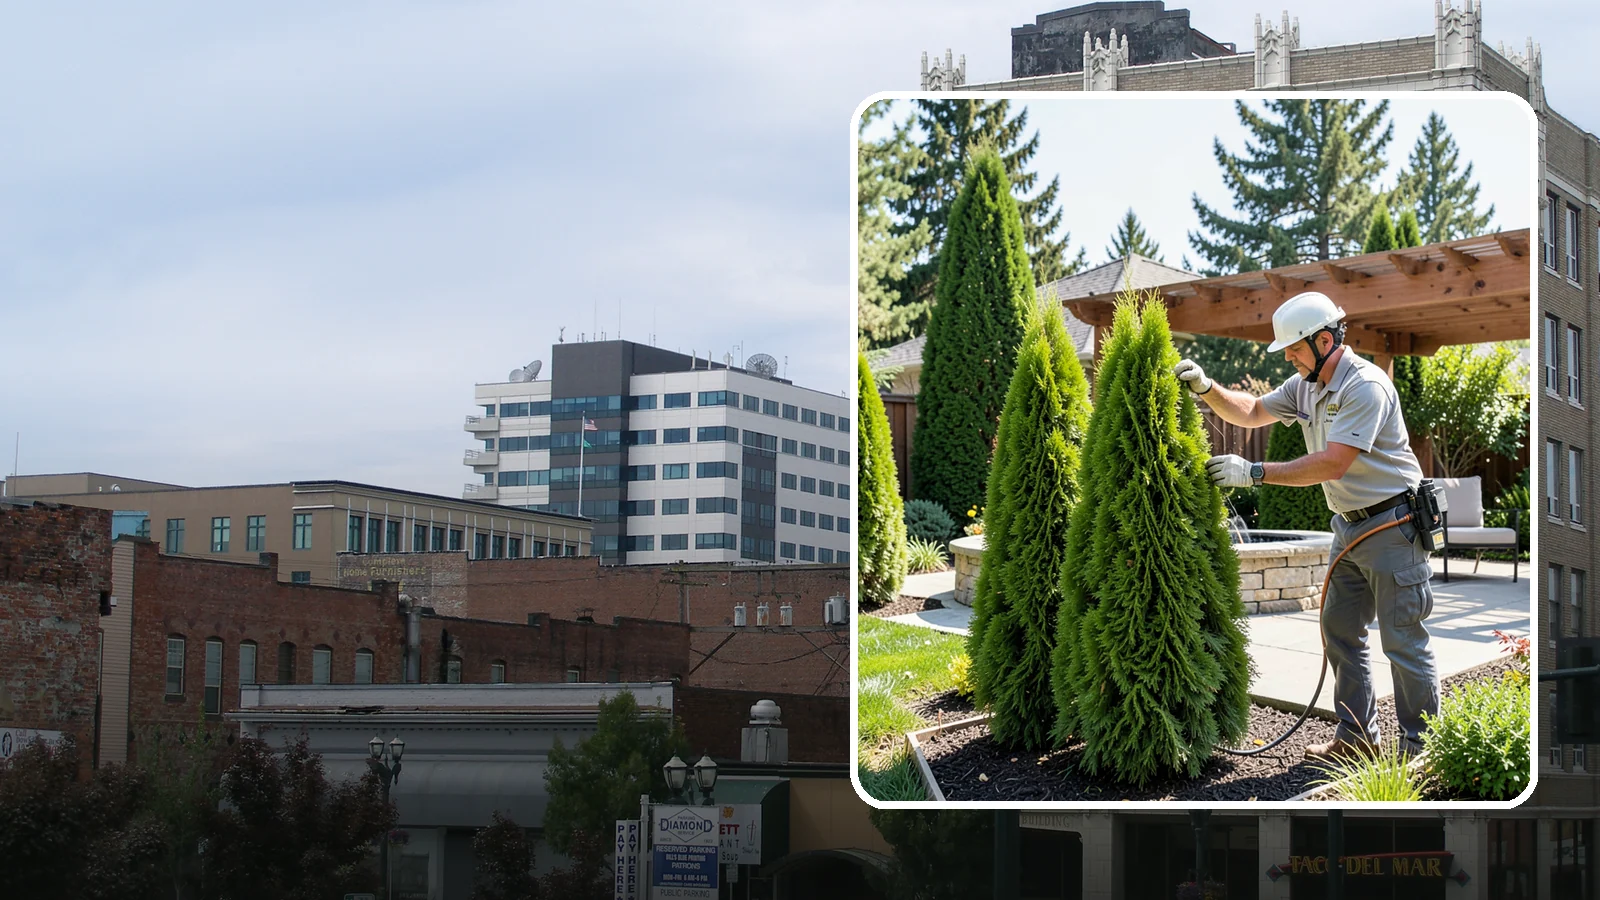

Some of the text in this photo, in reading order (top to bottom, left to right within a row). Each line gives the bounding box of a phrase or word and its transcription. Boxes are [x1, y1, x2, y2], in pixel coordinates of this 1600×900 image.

[370, 566, 426, 577] Furnishers
[660, 818, 713, 833] DIAMOND
[1022, 815, 1070, 828] BUILDING
[617, 824, 625, 852] PAY
[628, 824, 636, 852] PAY
[722, 852, 739, 861] Soup
[616, 856, 625, 894] HERE
[628, 856, 636, 893] HERE
[1289, 855, 1442, 877] TAC DEL MAR
[660, 889, 710, 898] PUBLIC PARKING
